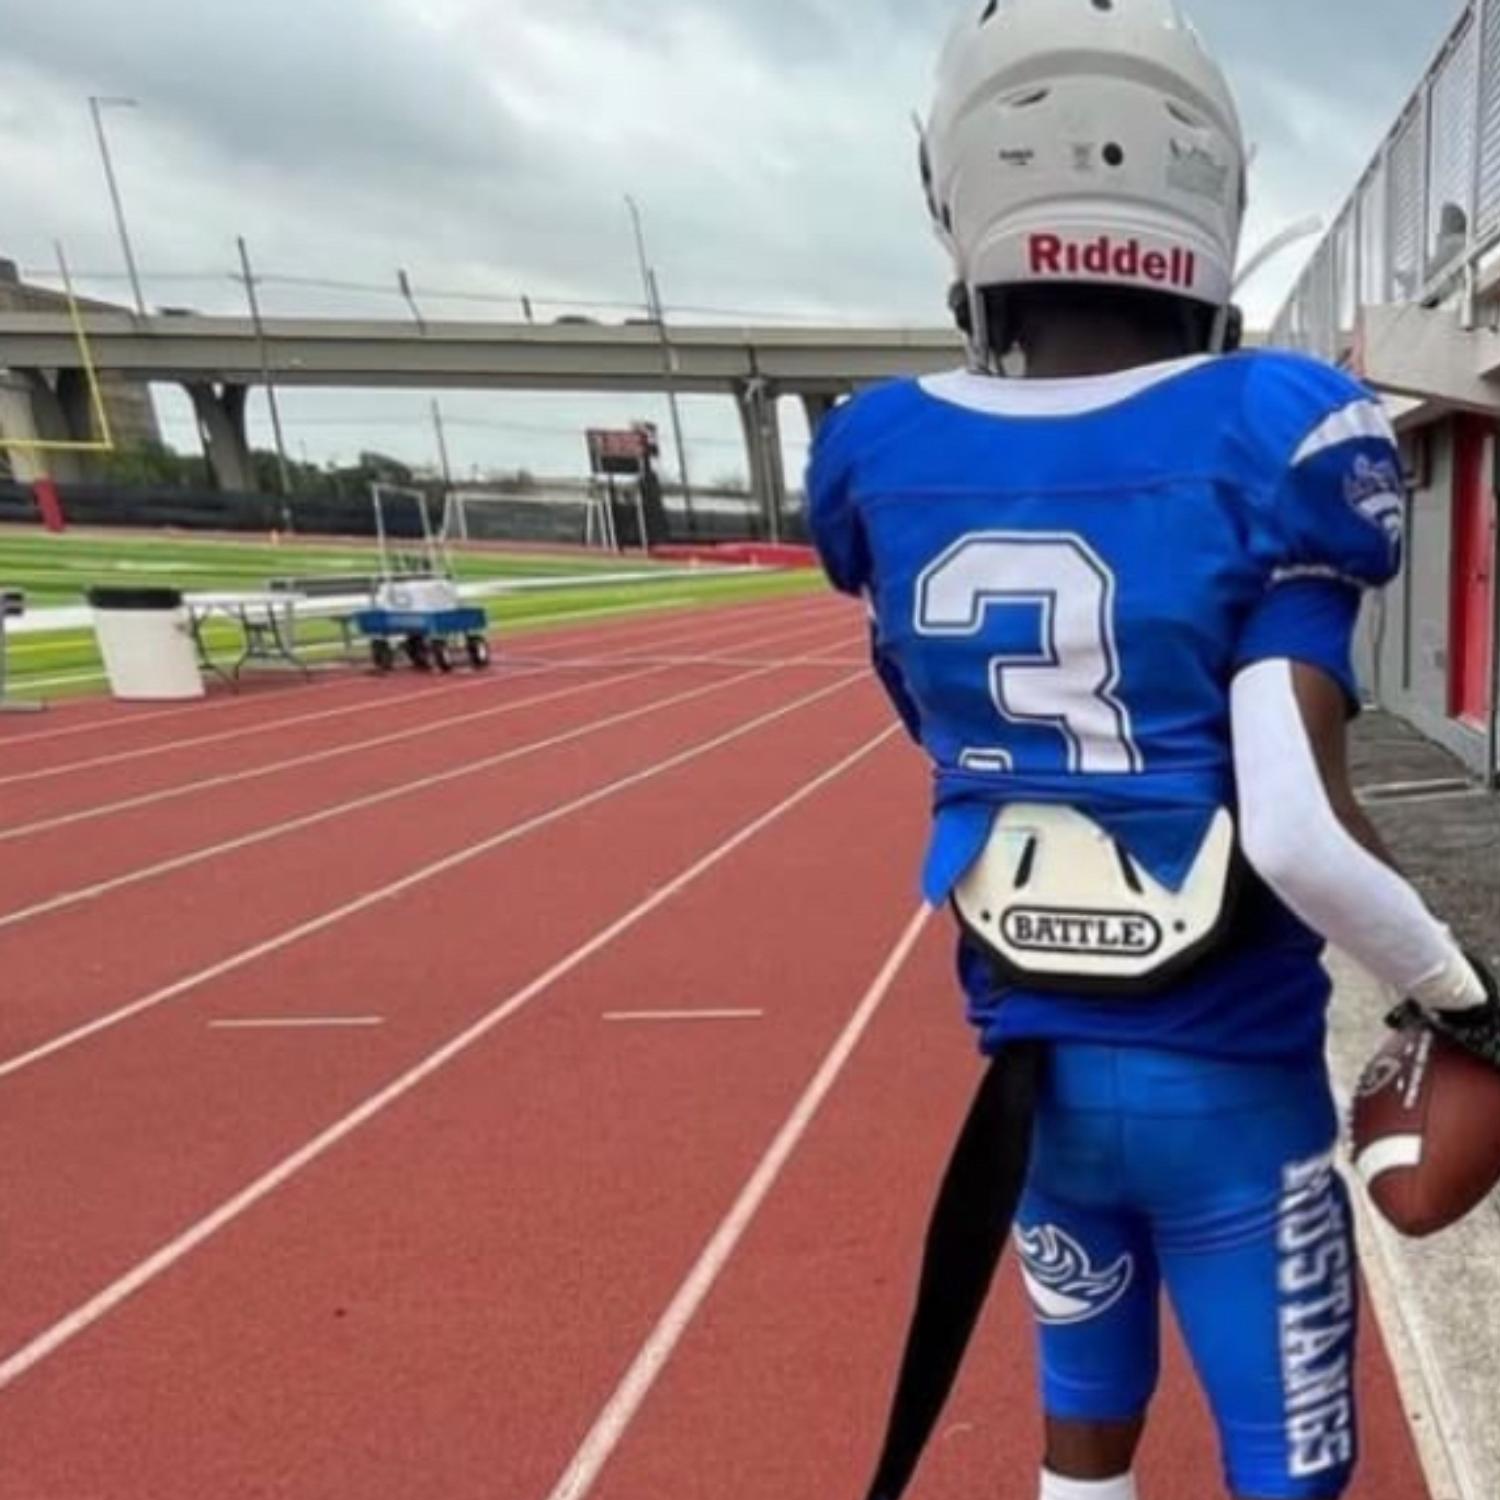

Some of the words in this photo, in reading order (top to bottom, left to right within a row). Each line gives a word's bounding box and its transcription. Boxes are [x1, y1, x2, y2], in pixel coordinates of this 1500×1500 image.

[1029, 233, 1194, 287] Riddell
[915, 531, 1144, 773] 3
[1014, 914, 1146, 946] BATTLE
